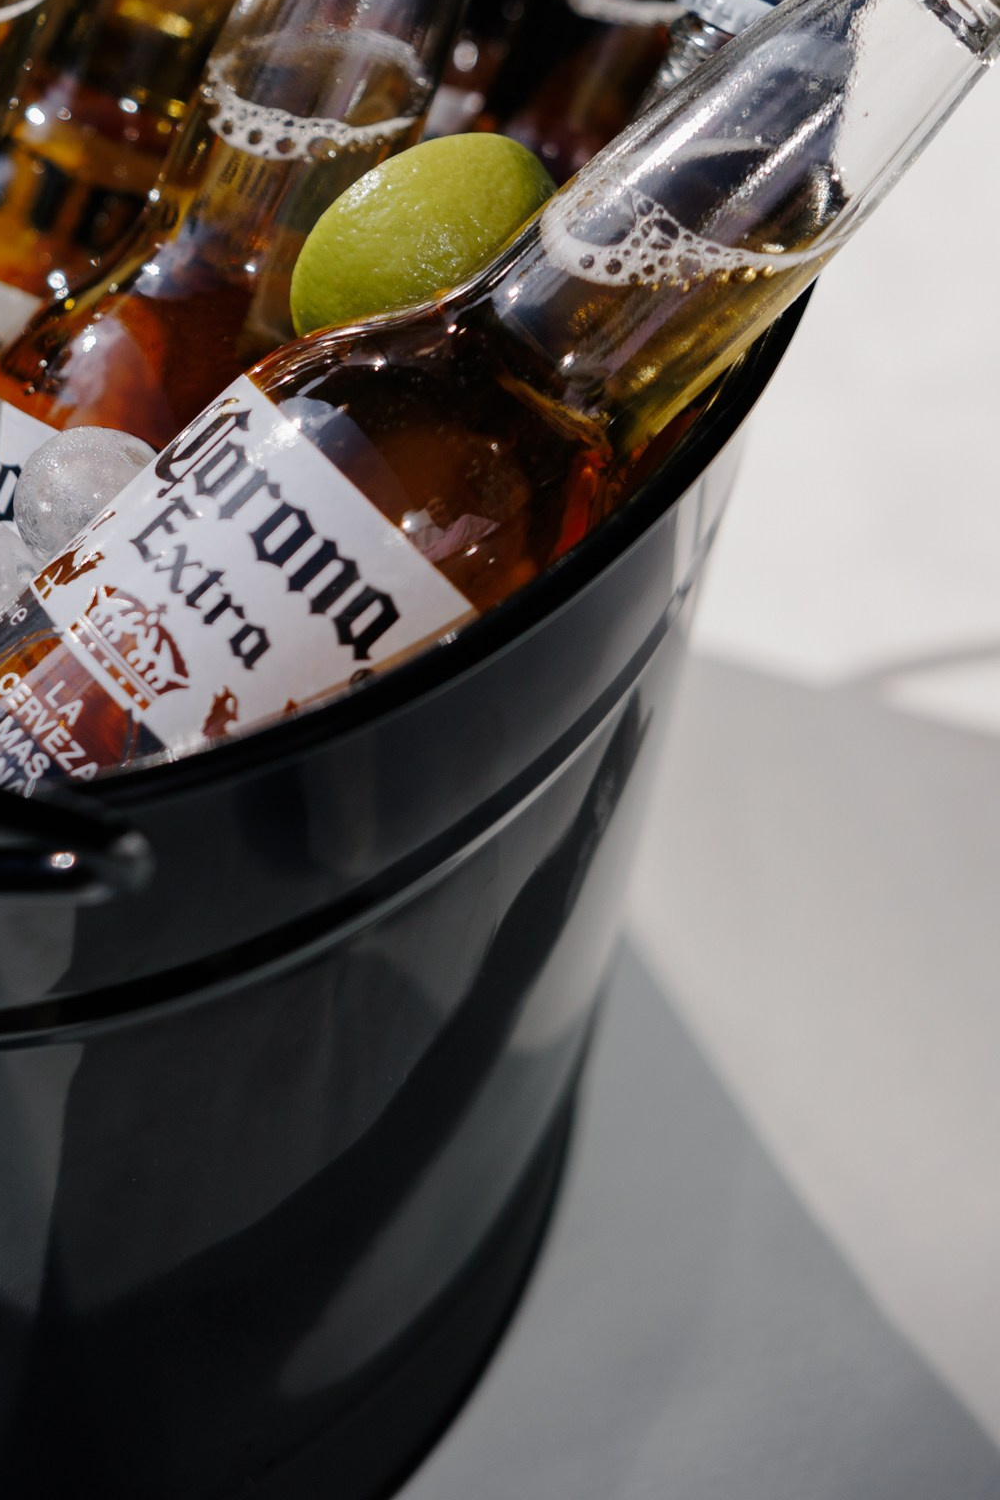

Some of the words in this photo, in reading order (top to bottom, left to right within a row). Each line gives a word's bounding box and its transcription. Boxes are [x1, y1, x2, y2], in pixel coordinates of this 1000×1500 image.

[130, 496, 272, 670] Extra
[154, 398, 400, 660] Corona
[46, 681, 84, 726] LA
